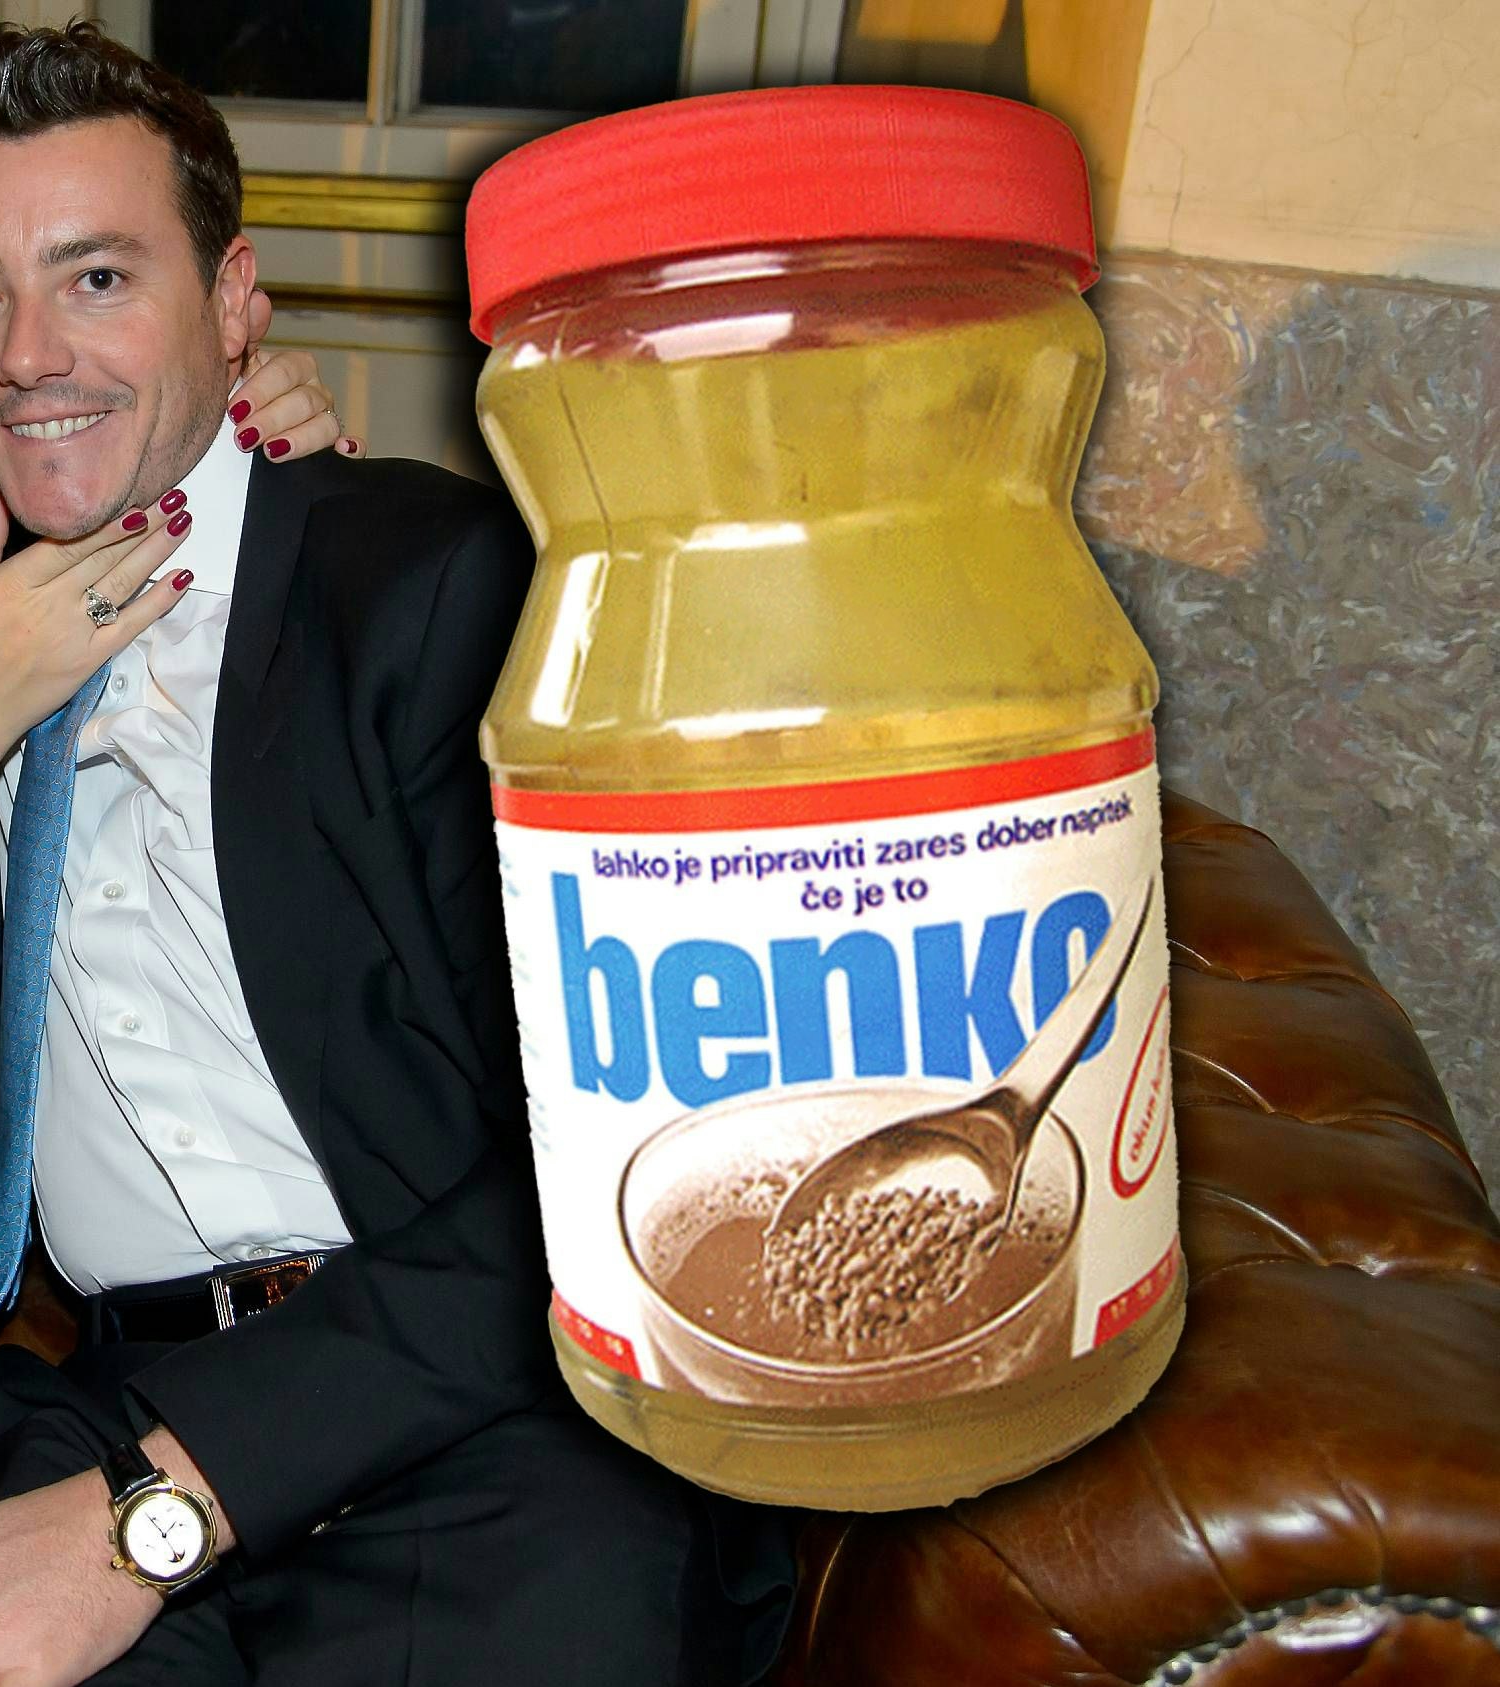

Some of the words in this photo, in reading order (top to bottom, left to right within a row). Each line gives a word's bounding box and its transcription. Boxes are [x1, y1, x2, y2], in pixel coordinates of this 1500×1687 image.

[592, 848, 670, 879] lahko
[674, 848, 702, 885] je
[710, 837, 866, 883] pripraviti
[875, 832, 966, 865] zares
[976, 816, 1057, 851] dober
[1060, 792, 1133, 835] napitek
[801, 880, 843, 910] če
[853, 877, 885, 916] je
[892, 877, 929, 902] to
[551, 871, 1118, 1108] benko
